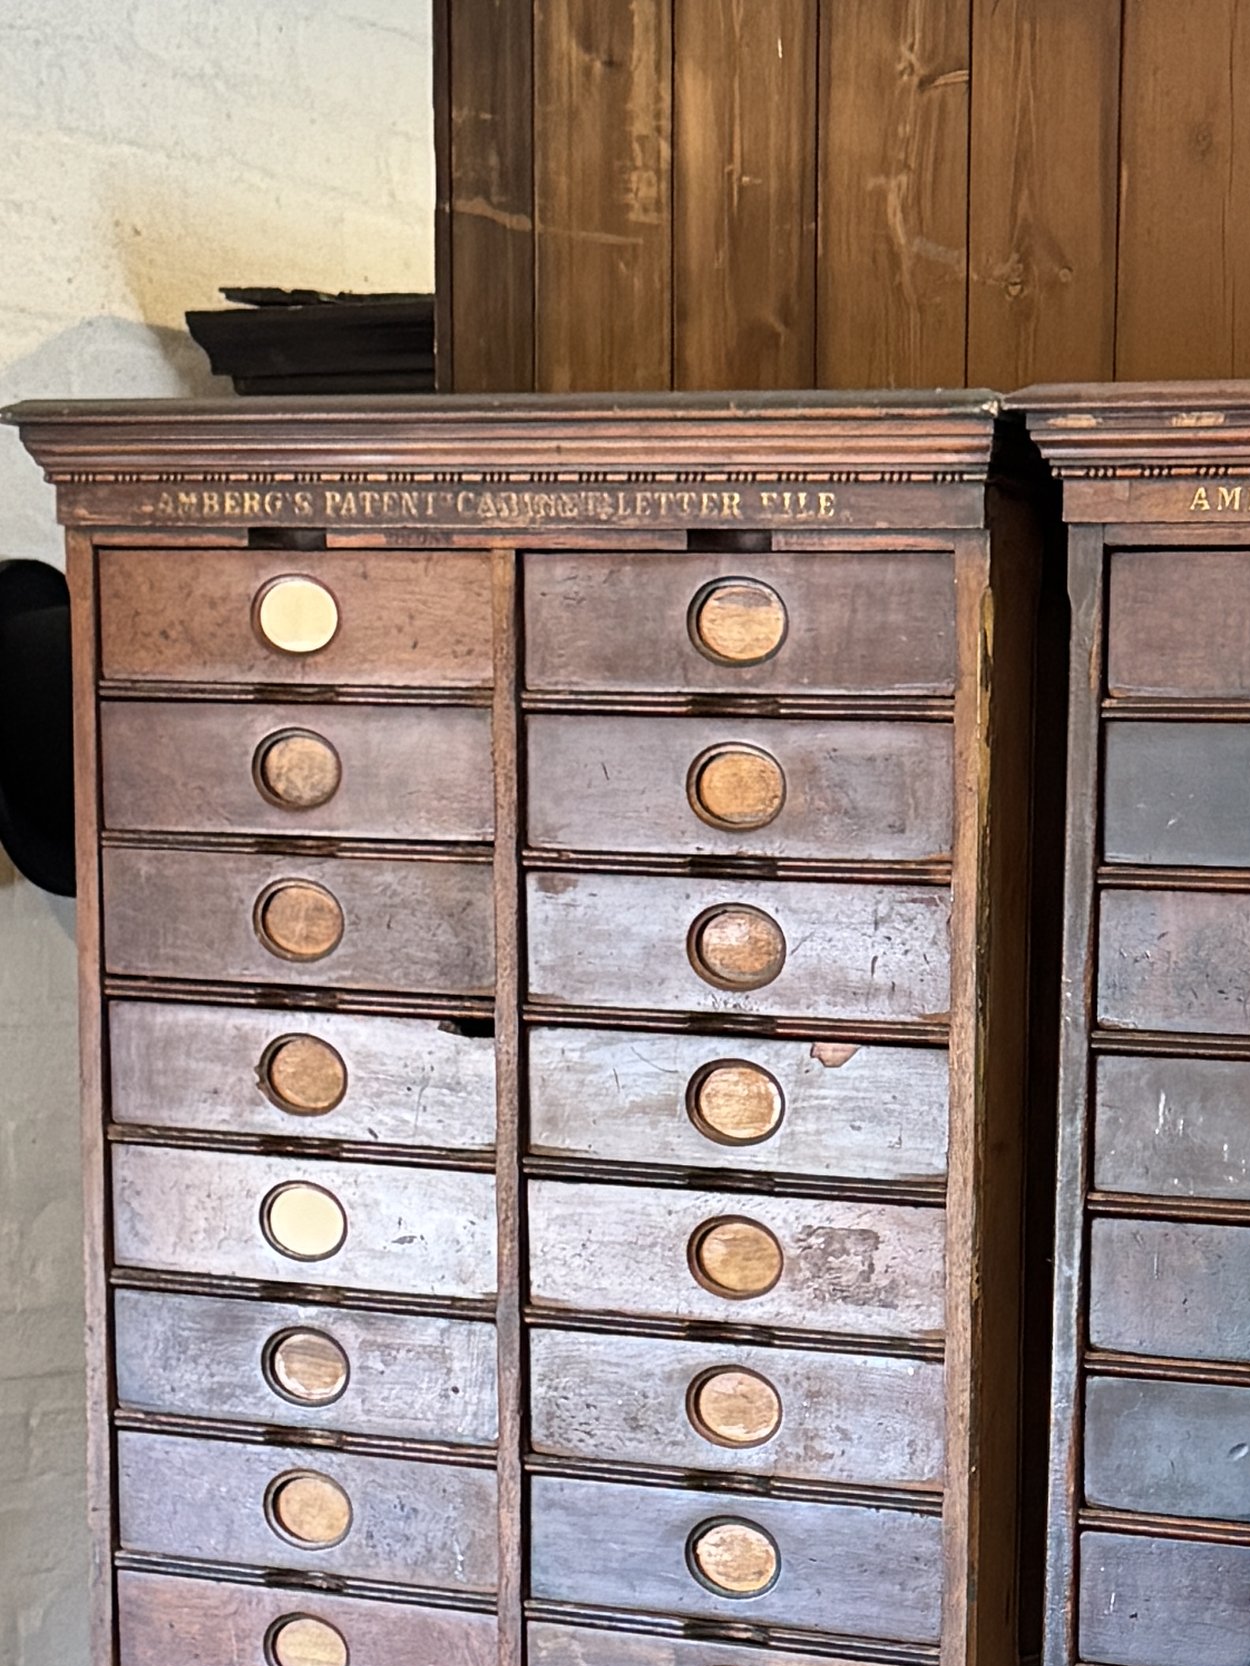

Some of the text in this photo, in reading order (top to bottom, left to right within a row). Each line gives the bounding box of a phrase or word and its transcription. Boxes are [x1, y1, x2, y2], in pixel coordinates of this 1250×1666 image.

[158, 490, 314, 516] AMBERG'S
[325, 490, 437, 517] PATENT
[617, 491, 743, 518] LETTER
